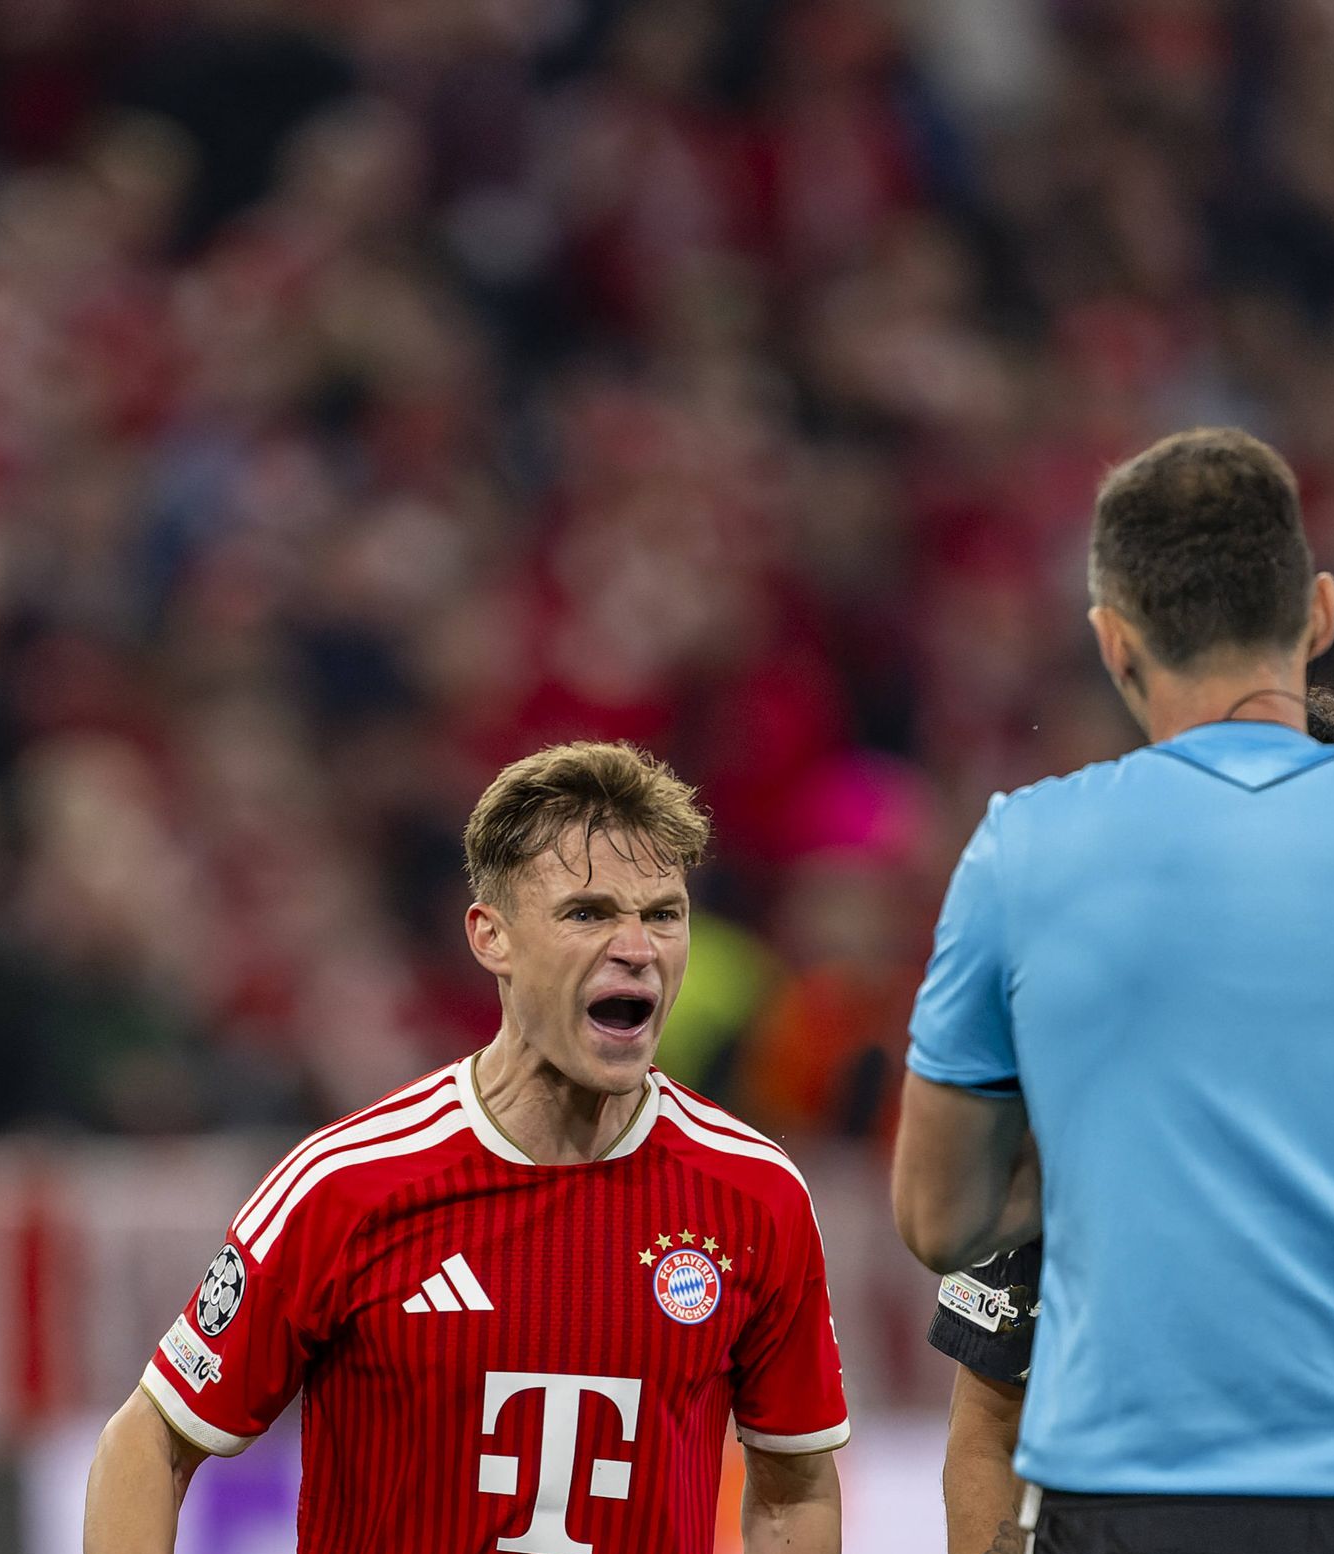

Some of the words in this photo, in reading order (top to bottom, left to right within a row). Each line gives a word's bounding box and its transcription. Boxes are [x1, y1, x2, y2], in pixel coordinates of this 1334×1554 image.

[660, 1263, 673, 1281] FC
[672, 1254, 716, 1284] BAYERN
[210, 1273, 226, 1306] 6
[977, 1292, 1000, 1319] 10
